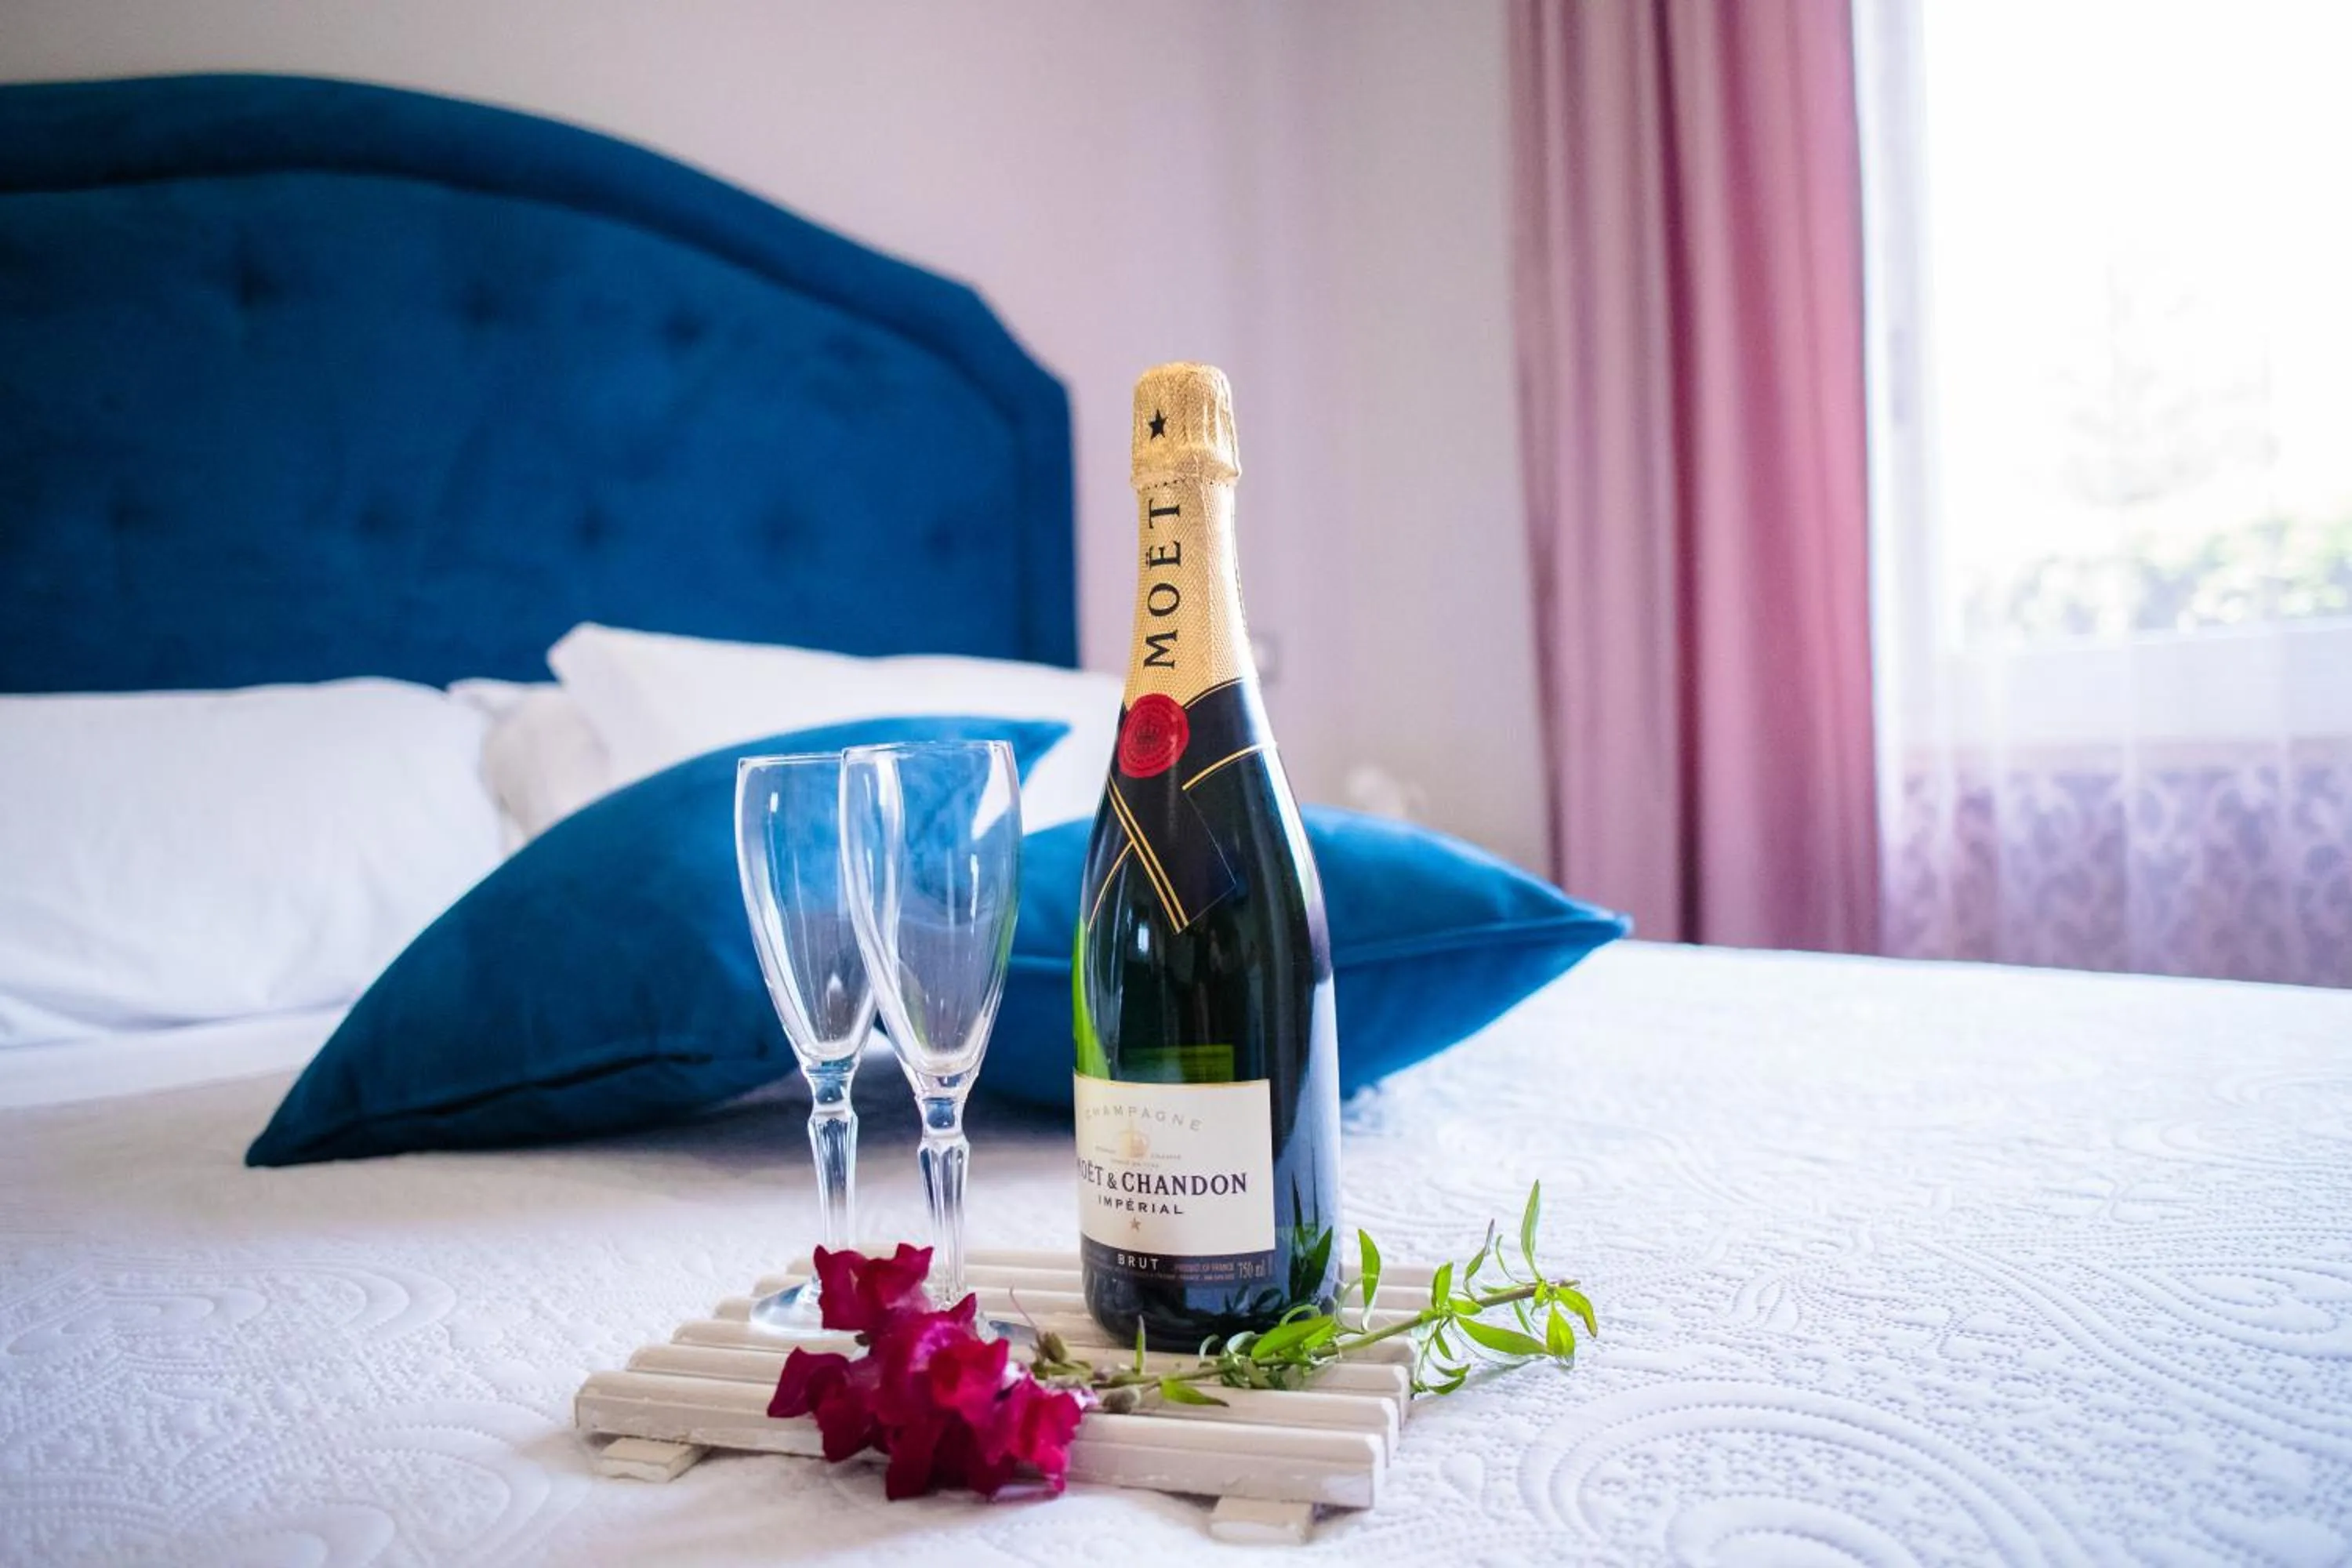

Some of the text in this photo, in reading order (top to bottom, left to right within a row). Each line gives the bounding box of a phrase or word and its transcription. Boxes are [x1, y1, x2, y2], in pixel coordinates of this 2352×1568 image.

[1143, 499, 1181, 670] MOËT
[1086, 1105, 1202, 1131] CHAMPAGNE
[1107, 1172, 1118, 1190] &
[1122, 1171, 1247, 1196] CHANDON
[1098, 1194, 1184, 1215] IMPÉRIAL
[1117, 1254, 1159, 1270] BRUT
